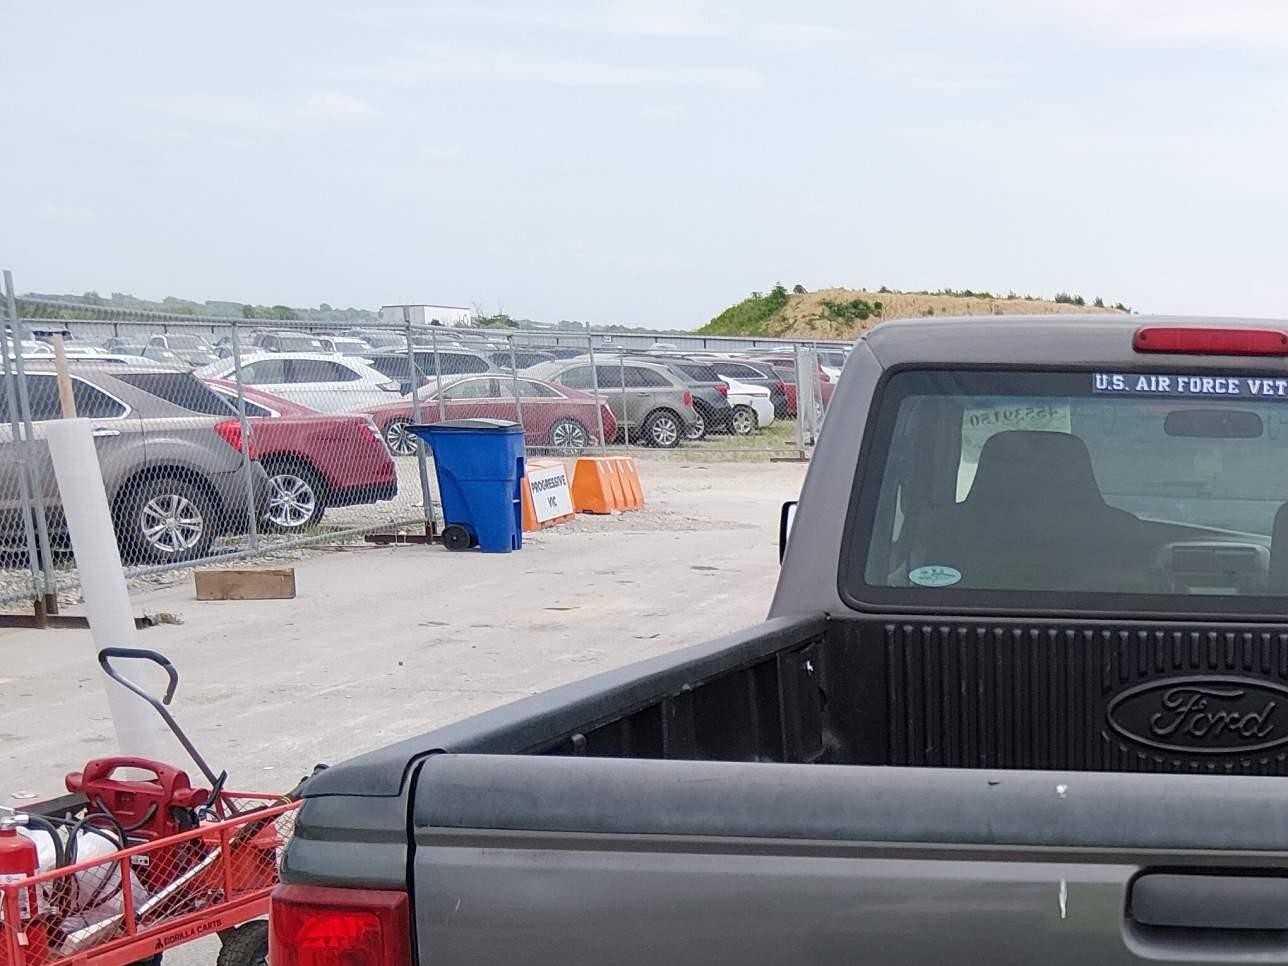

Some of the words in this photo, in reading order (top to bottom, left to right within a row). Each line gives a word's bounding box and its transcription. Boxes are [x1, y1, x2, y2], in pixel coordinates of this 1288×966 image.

[1095, 374, 1129, 391] U.S.
[1135, 376, 1171, 392] AIR
[1177, 377, 1240, 395] FORCE
[1151, 686, 1276, 737] Ford
[163, 928, 196, 946] GORILLA
[197, 919, 223, 934] CARTS
